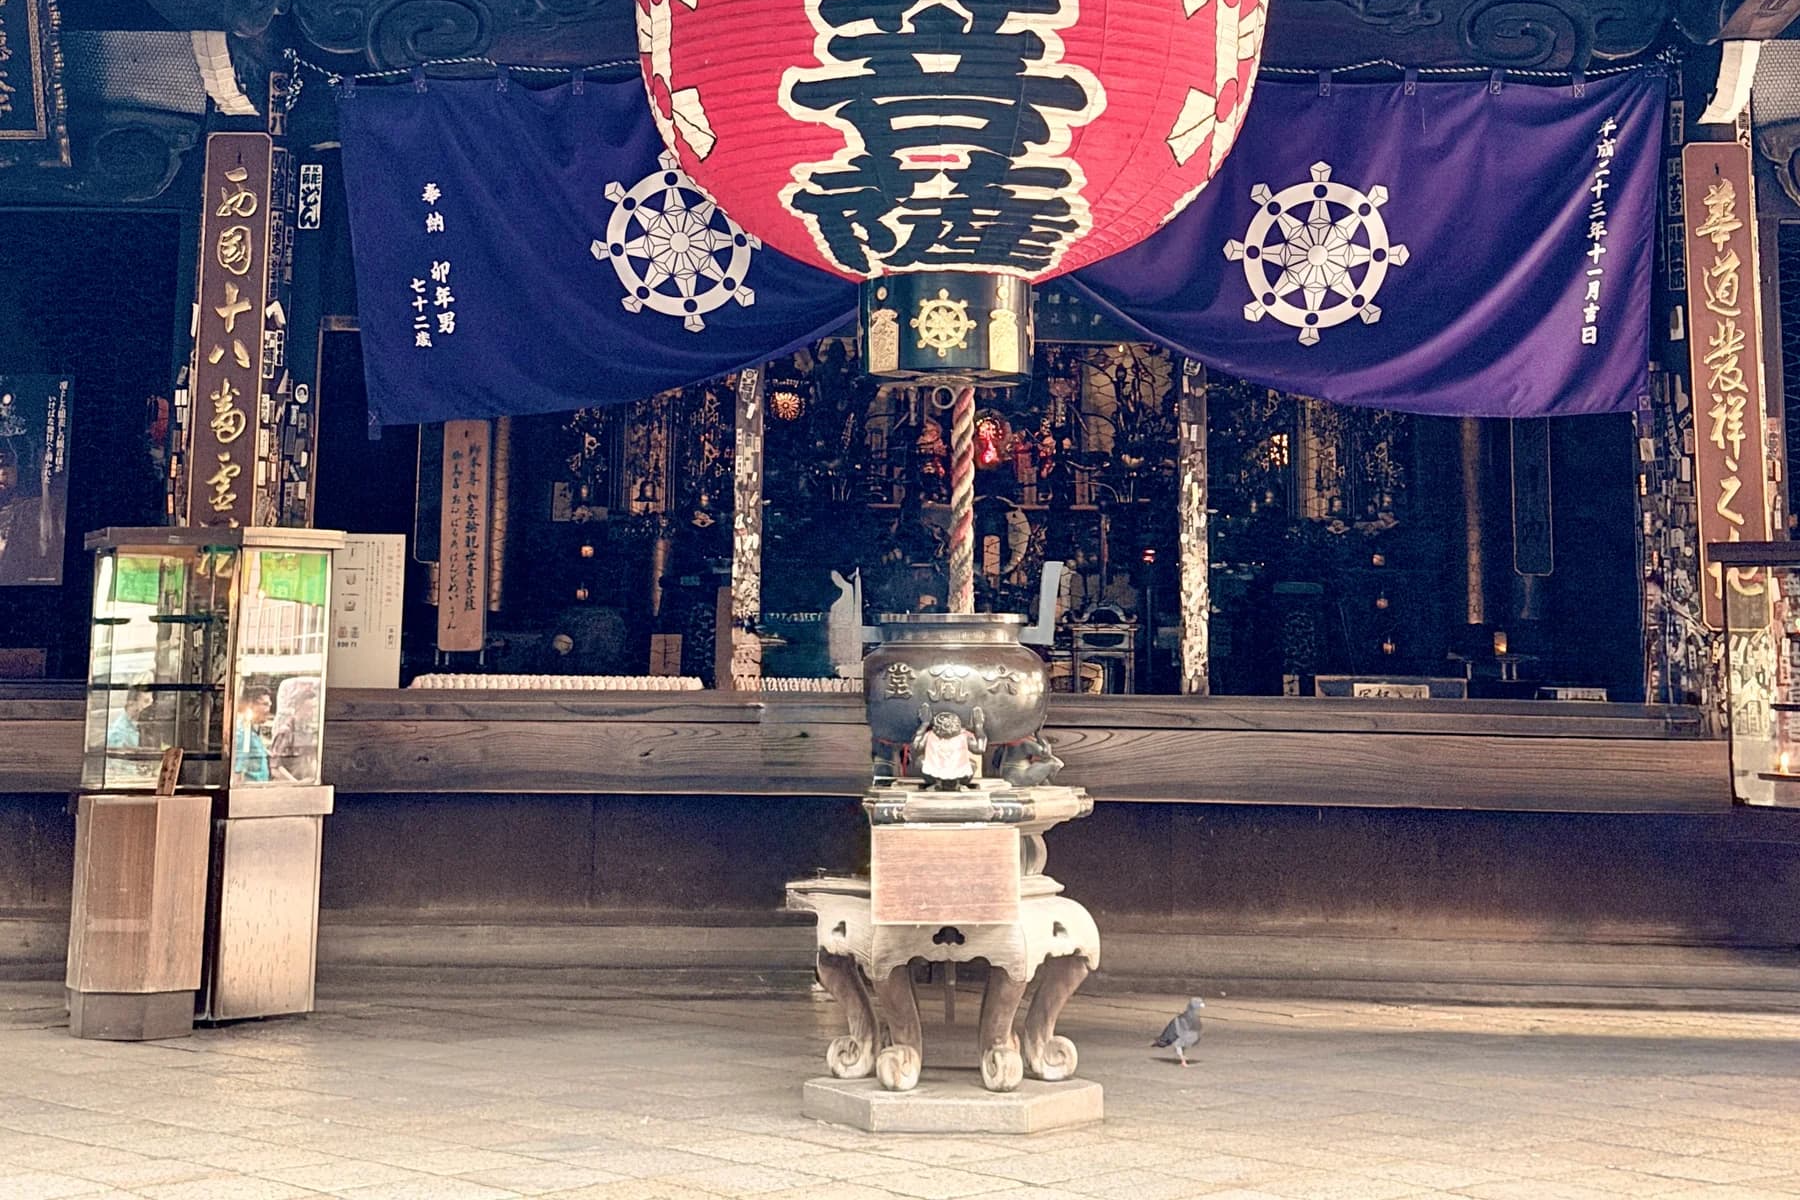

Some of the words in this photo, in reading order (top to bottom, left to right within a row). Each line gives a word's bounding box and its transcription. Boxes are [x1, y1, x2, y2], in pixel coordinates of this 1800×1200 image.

[421, 183, 445, 233] 奉納
[1581, 117, 1617, 345] 平成二十三年十一月吉日
[410, 278, 433, 347] 七十二歳
[430, 261, 456, 334] 卯年男
